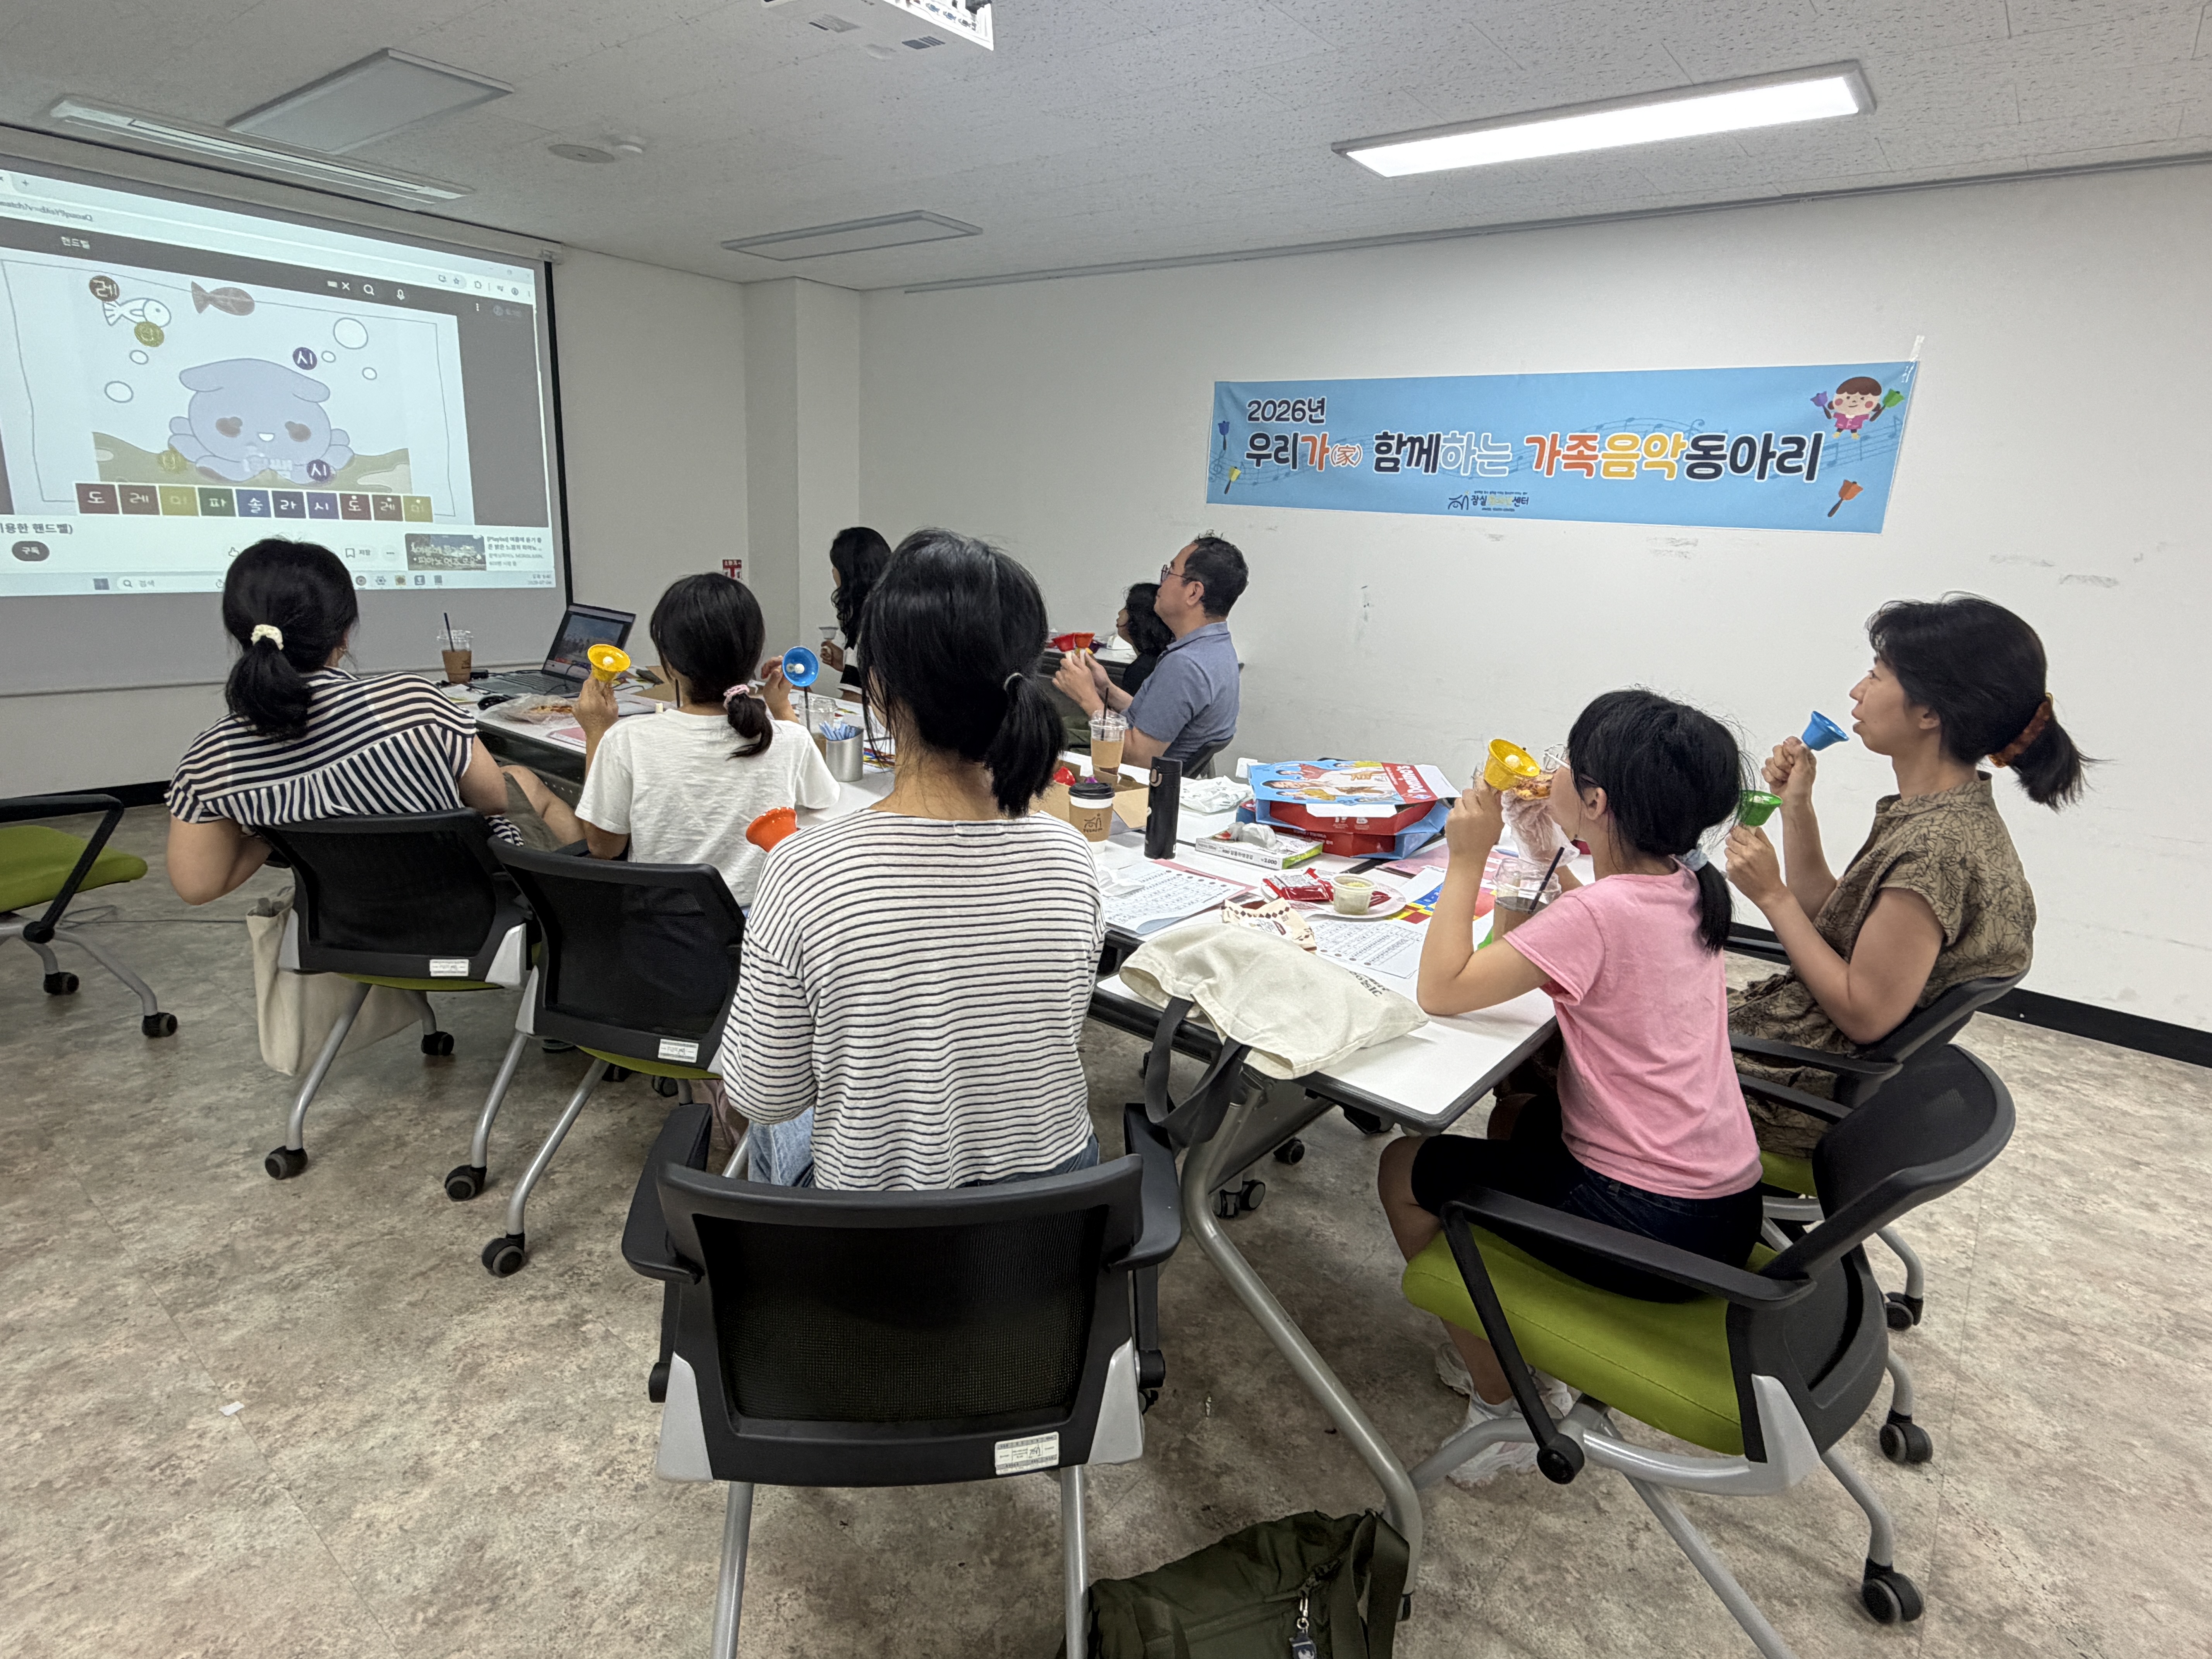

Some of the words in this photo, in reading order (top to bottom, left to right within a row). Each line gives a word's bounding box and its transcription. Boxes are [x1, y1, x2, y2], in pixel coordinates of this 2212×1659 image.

[92, 279, 117, 297] 레
[297, 350, 313, 365] 시
[1247, 397, 1326, 424] 2026년
[1374, 430, 1513, 477] 함께하는
[1524, 432, 1824, 483] 가족음악동아리
[311, 463, 327, 476] 시
[87, 491, 105, 503] 도
[129, 493, 149, 504] 레
[170, 496, 187, 505] 미
[209, 498, 227, 507] 파
[247, 497, 263, 514] 솔
[280, 500, 297, 510] 라
[314, 502, 329, 510] 시
[348, 500, 361, 512] 도
[380, 501, 395, 511] 레
[1396, 765, 1427, 793] Domino's
